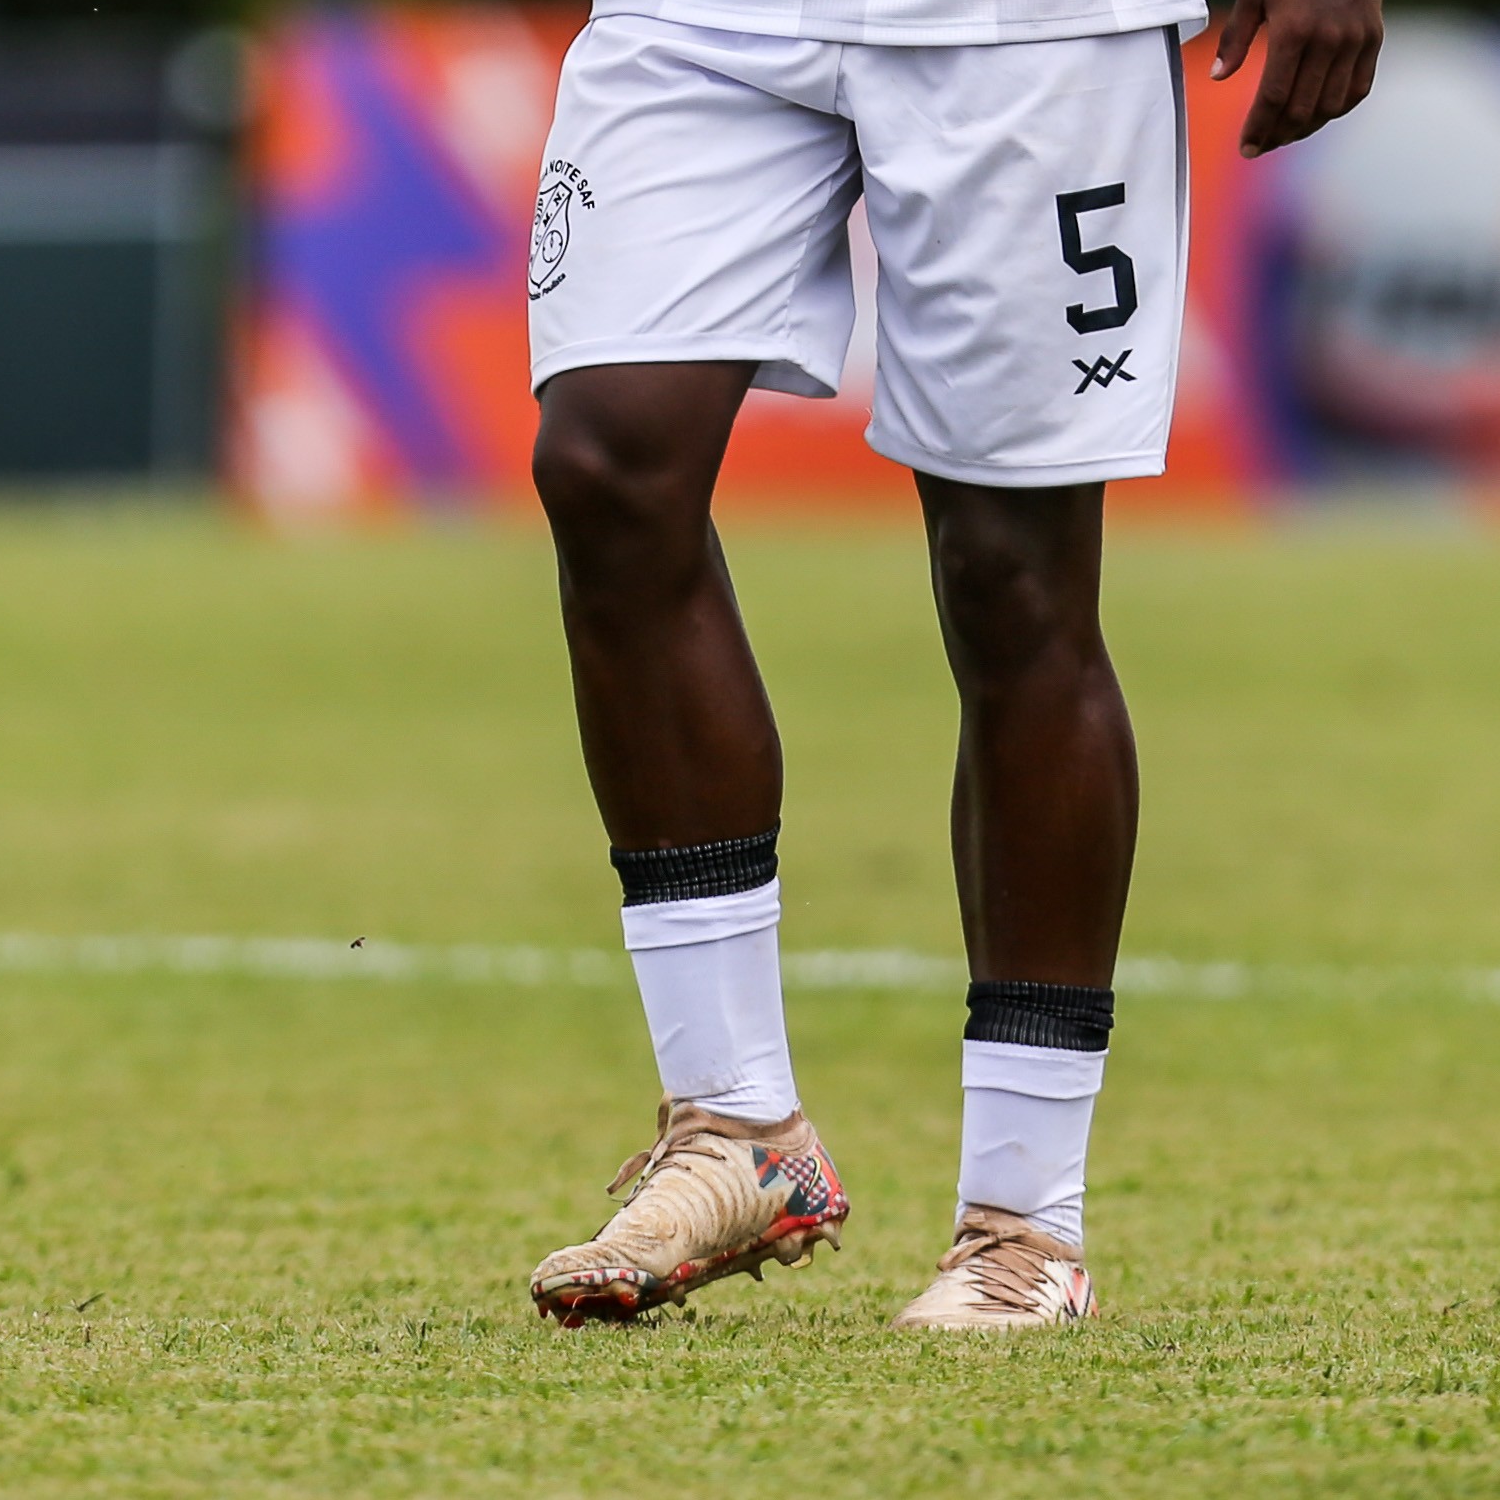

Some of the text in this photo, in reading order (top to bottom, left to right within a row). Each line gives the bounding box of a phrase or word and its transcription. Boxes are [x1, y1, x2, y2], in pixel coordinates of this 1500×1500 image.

[550, 159, 595, 210] NOITE SAF
[1055, 181, 1139, 335] 5
